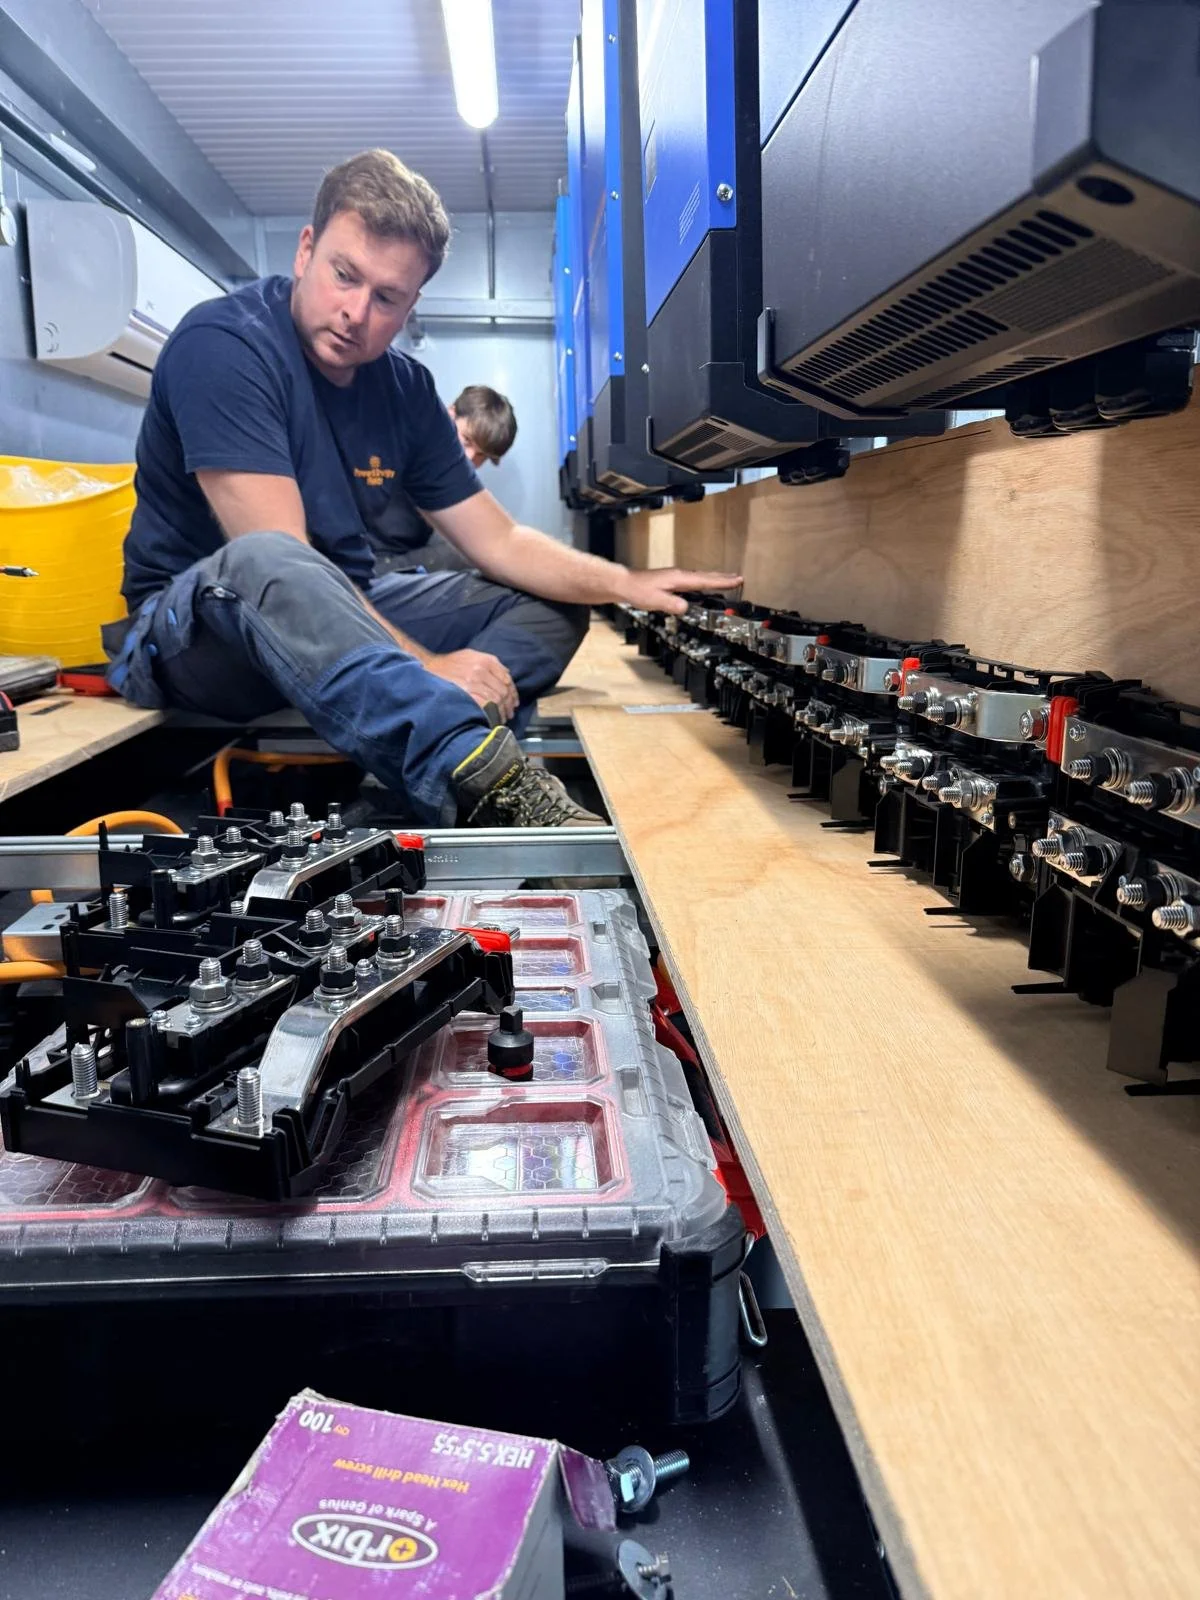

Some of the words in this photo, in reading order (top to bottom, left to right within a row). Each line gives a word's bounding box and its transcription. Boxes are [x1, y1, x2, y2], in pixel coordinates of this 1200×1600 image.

[299, 1410, 334, 1433] 100
[492, 1443, 535, 1468] HEX
[332, 1458, 374, 1474] screw
[372, 1466, 403, 1482] drill
[402, 1471, 440, 1488] Head
[441, 1477, 470, 1494] Hex
[319, 1498, 367, 1514] Genius
[367, 1503, 384, 1515] of
[386, 1506, 424, 1527] Spark
[424, 1518, 438, 1531] A
